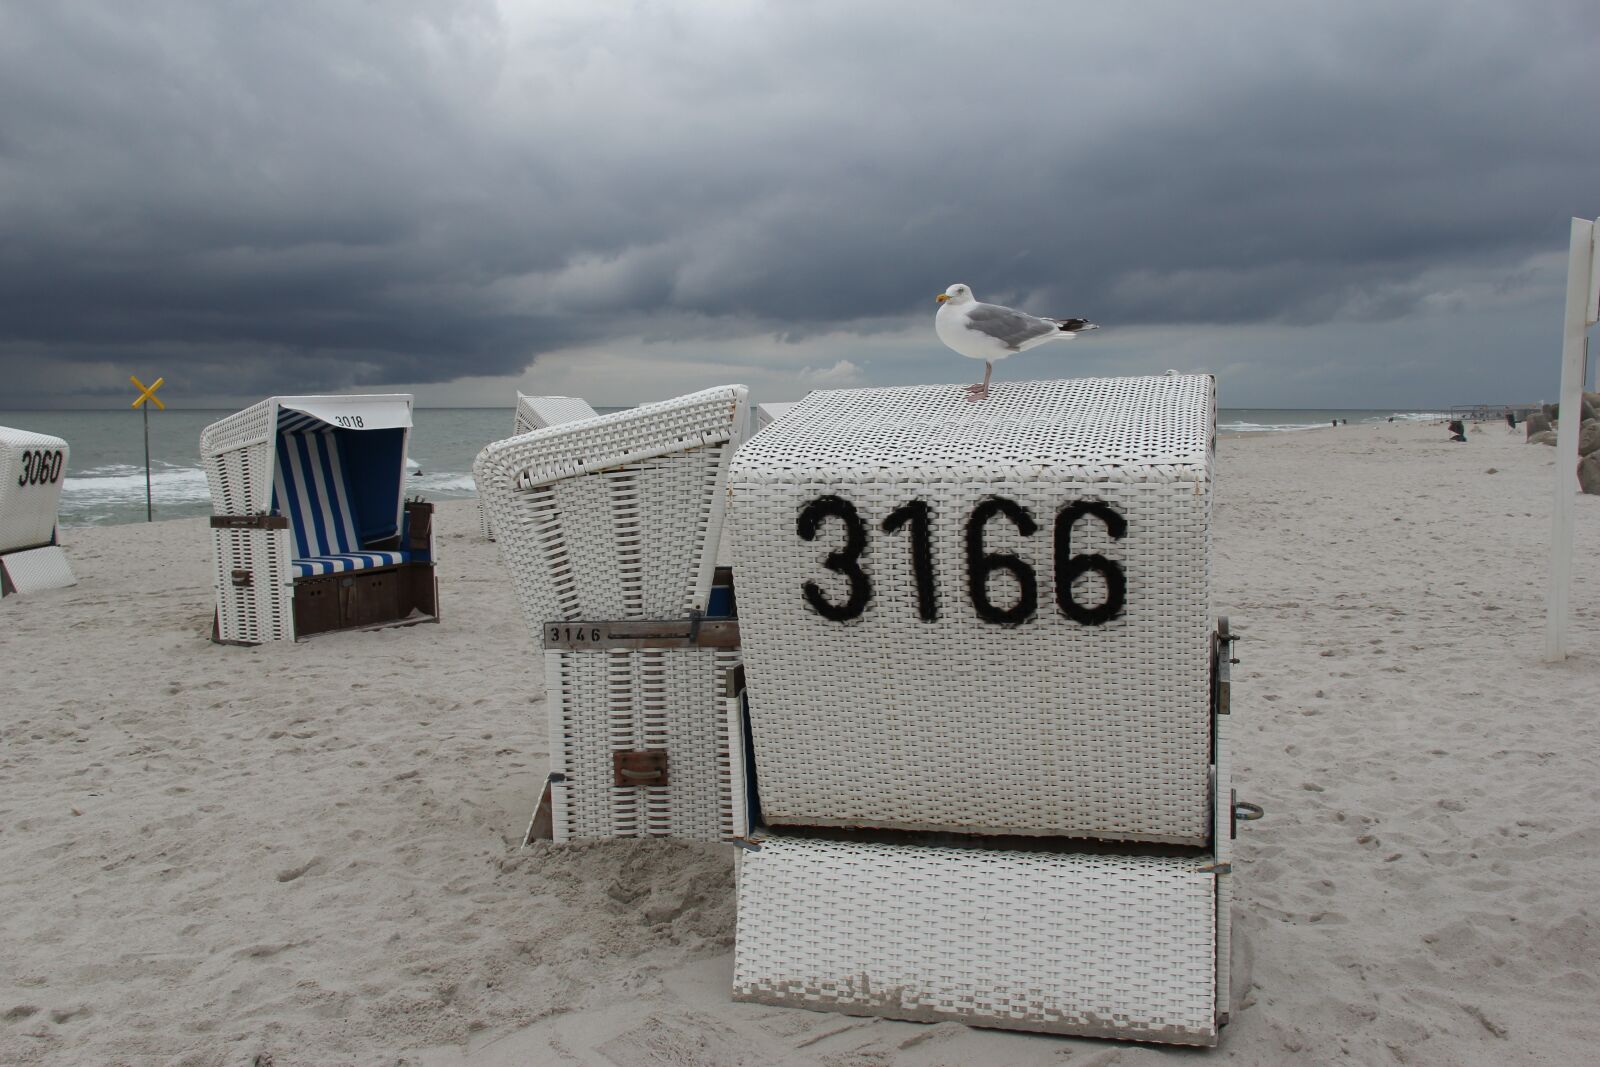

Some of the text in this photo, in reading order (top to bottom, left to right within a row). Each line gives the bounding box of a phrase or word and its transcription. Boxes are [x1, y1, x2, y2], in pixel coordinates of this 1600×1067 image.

[335, 415, 364, 428] 3018
[18, 450, 63, 487] 3060
[797, 495, 1128, 626] 3166
[550, 627, 600, 642] 3146
